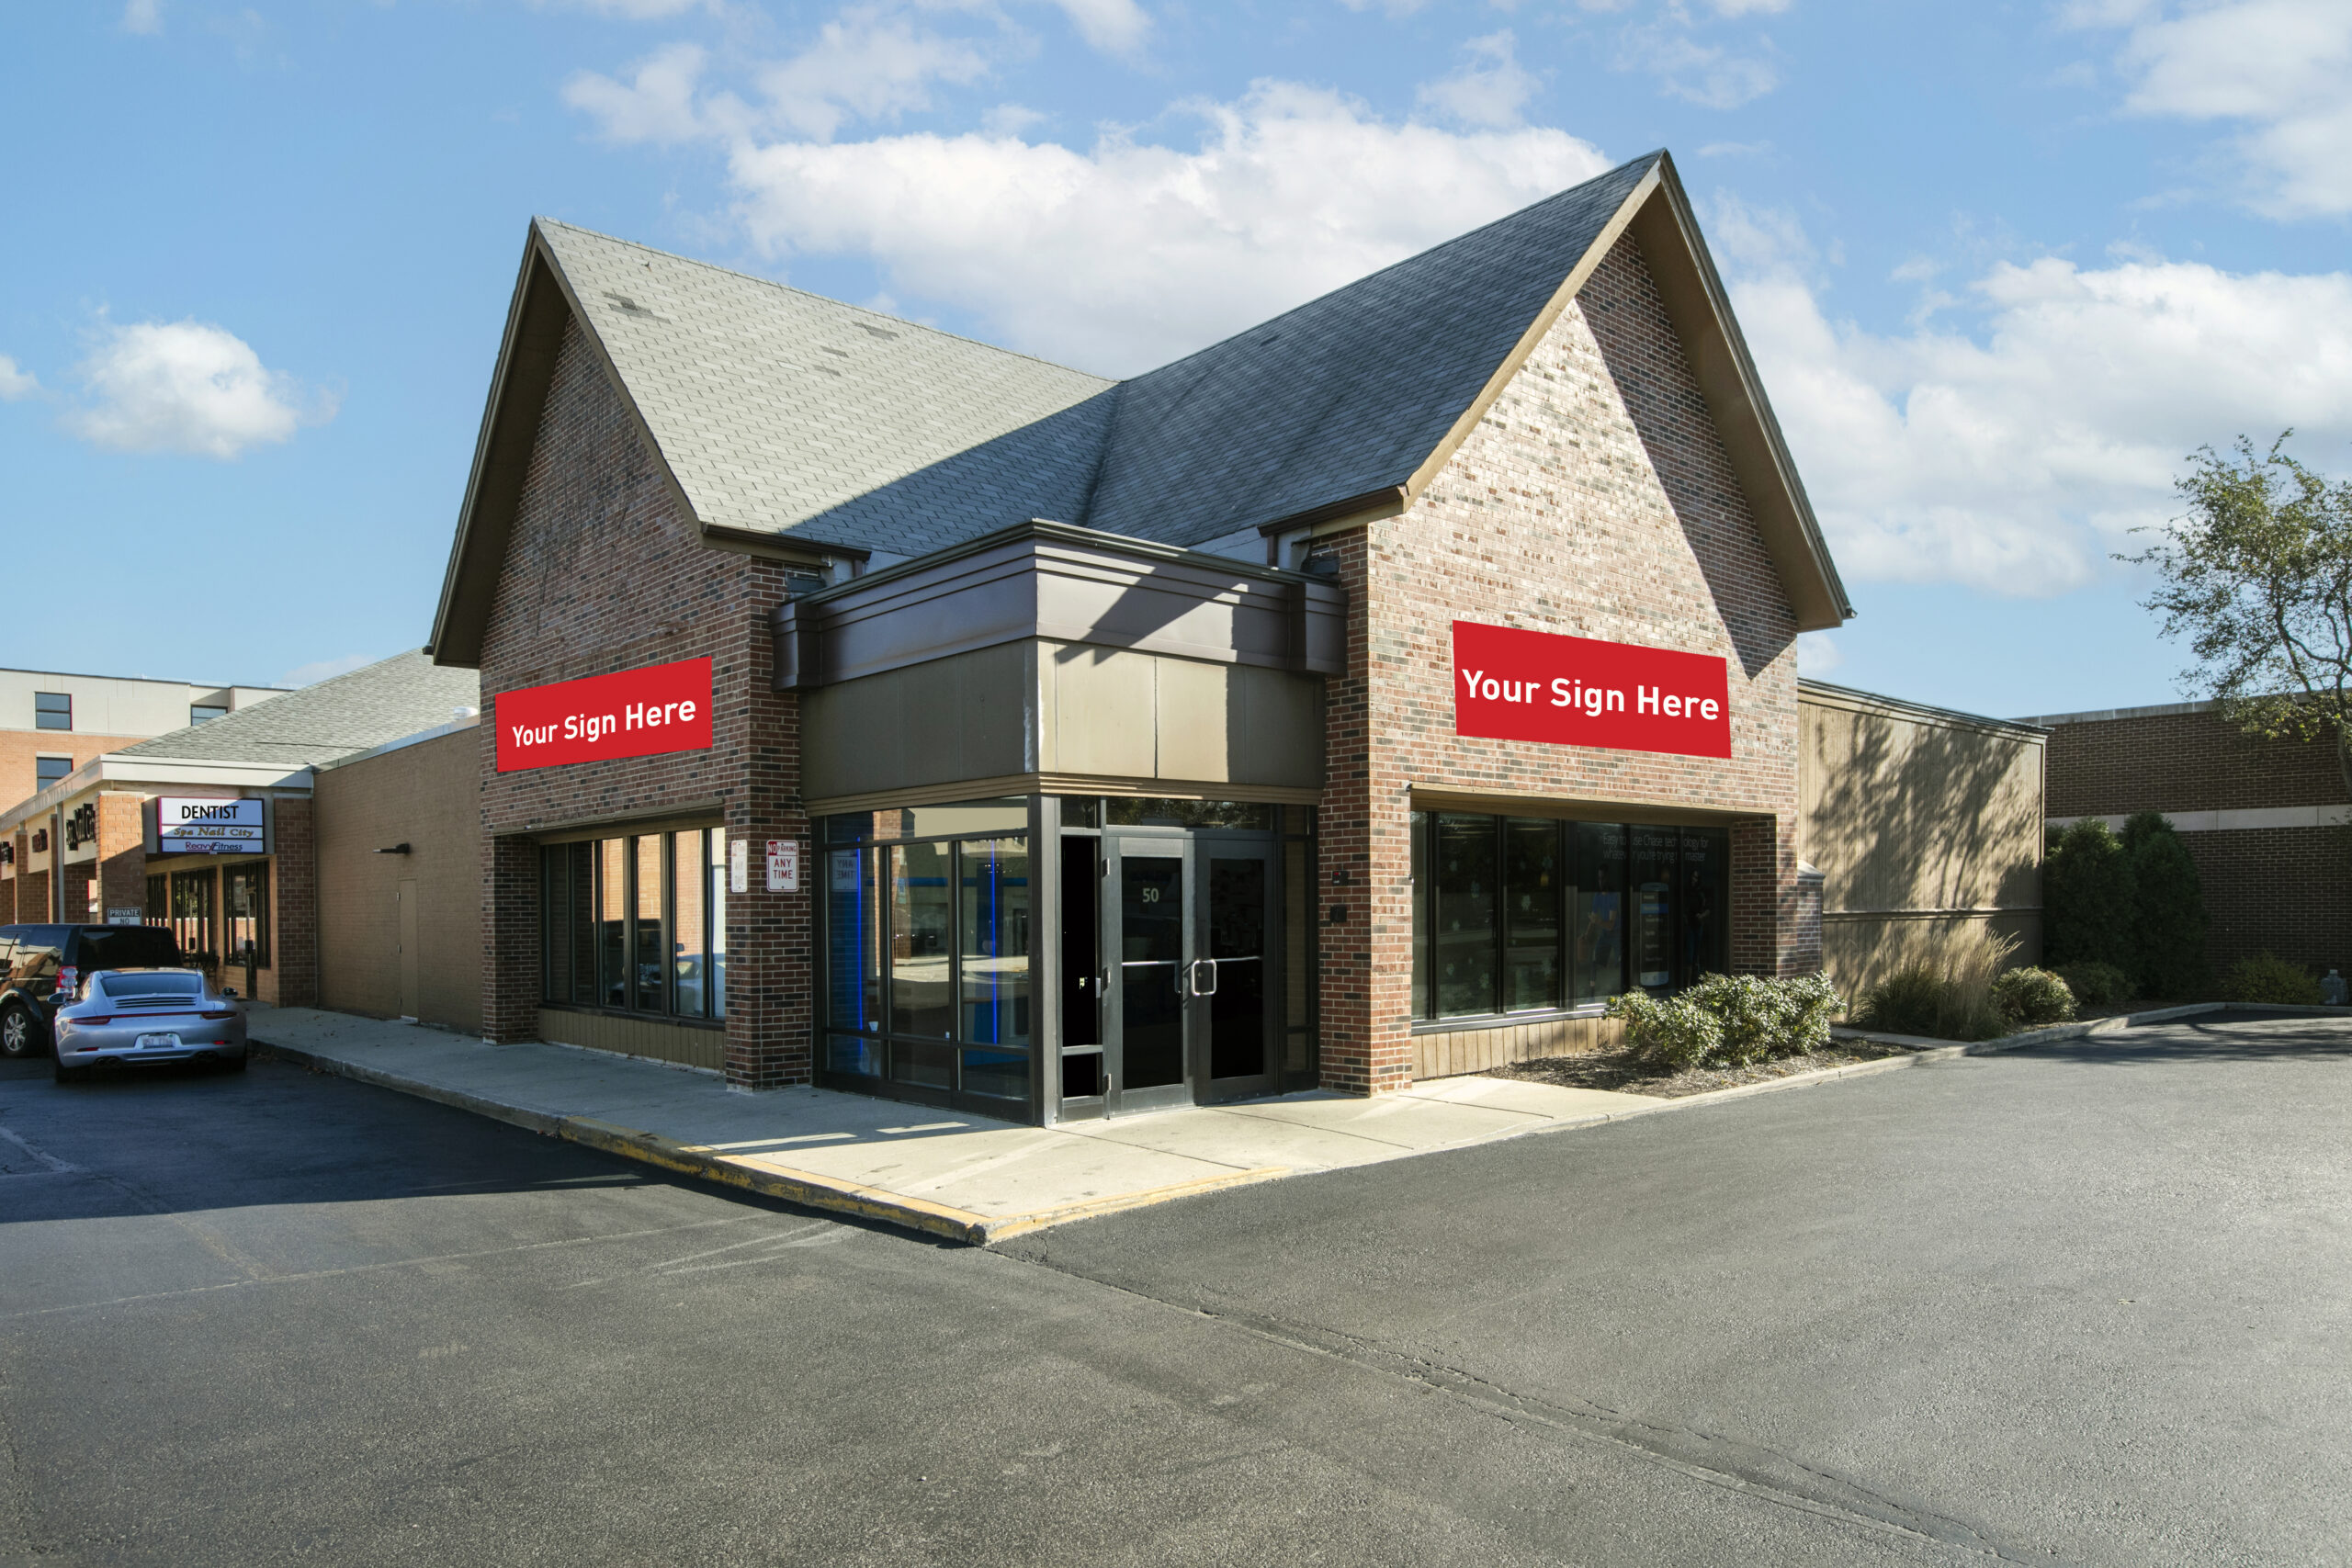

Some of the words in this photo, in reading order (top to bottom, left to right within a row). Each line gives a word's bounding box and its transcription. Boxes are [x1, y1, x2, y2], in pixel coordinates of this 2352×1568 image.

[1462, 669, 1542, 704] Your
[1550, 678, 1625, 717] Sign
[1637, 685, 1719, 720] Here
[512, 724, 559, 748] Your
[563, 714, 616, 742] Sign
[626, 700, 696, 730] Here
[181, 806, 239, 819] DENTIST
[174, 828, 194, 838] Spa
[198, 827, 226, 837] Nail
[230, 829, 254, 838] City
[1643, 834, 1663, 847] Chase
[768, 843, 777, 853] NO
[777, 845, 797, 853] PARKING
[774, 858, 792, 868] ANY
[773, 869, 794, 880] TIME
[1143, 887, 1159, 903] 50
[109, 908, 140, 917] PRIVATE
[119, 918, 130, 926] NO
